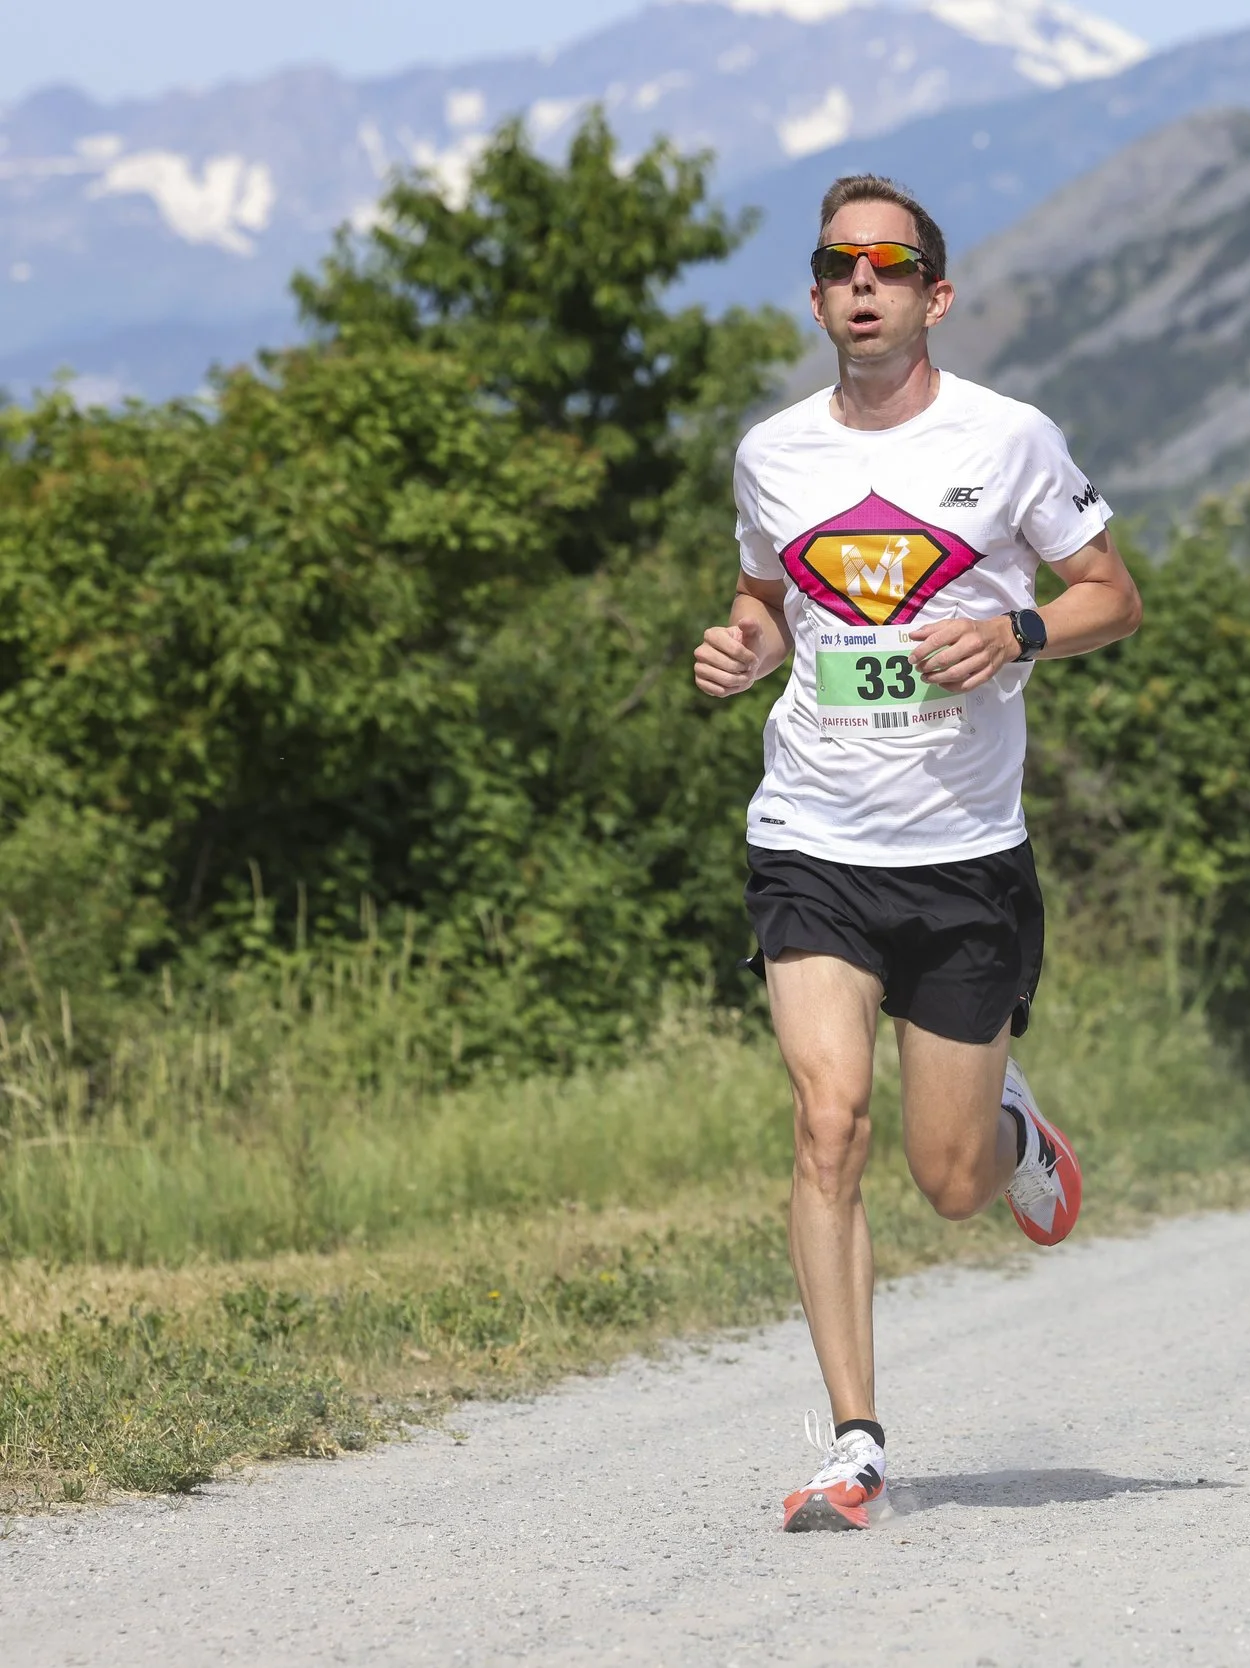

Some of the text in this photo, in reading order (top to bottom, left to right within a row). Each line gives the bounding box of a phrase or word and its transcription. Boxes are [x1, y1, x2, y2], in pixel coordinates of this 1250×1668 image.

[820, 633, 877, 646] stv gampel
[898, 630, 912, 643] lo
[855, 655, 916, 700] 33
[912, 706, 963, 724] RAIFFEISEN
[822, 717, 869, 727] RAIFFEISEN
